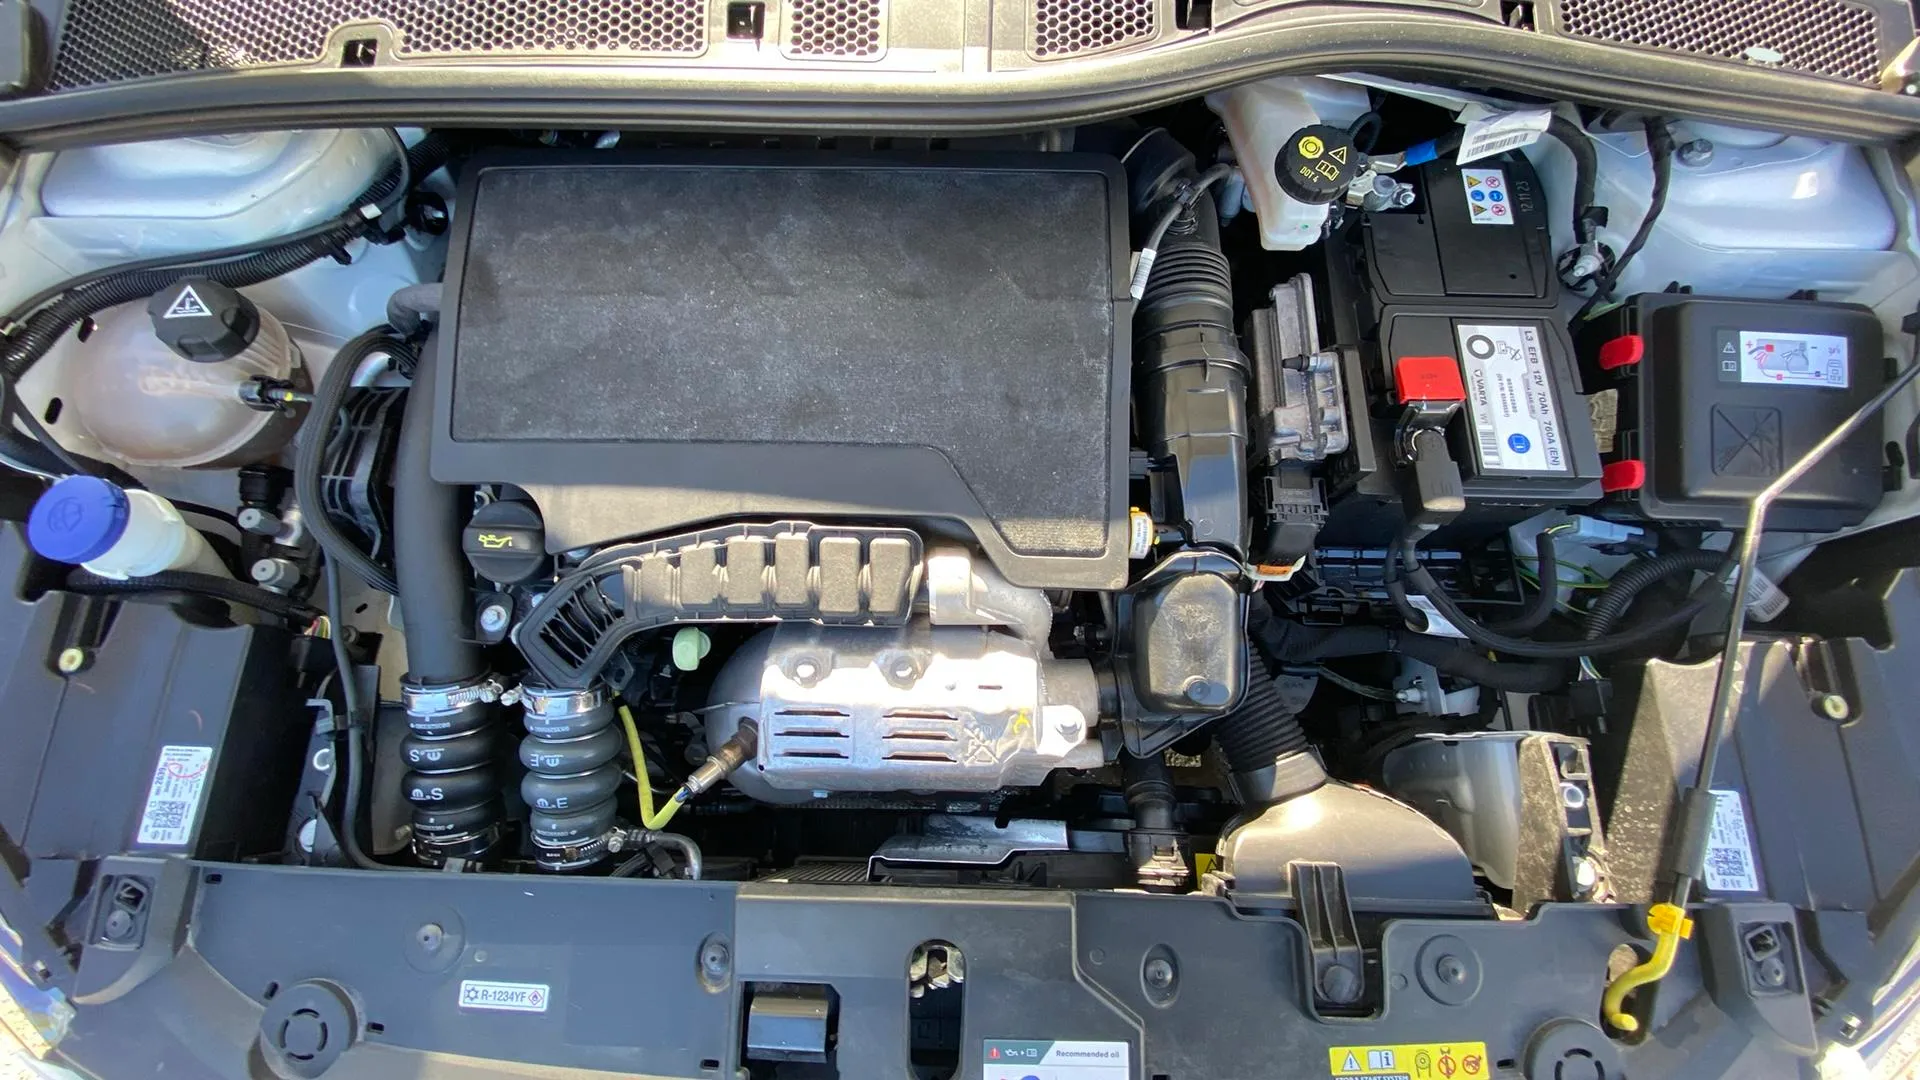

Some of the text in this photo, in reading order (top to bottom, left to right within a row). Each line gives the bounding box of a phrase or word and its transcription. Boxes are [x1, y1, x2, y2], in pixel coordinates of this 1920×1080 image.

[1300, 166, 1319, 183] DOT 4
[1524, 330, 1534, 341] L3
[1528, 346, 1539, 364] EFB
[1532, 370, 1544, 387] 12V
[1475, 378, 1488, 406] VARTA
[1537, 392, 1549, 415] 70Ah
[1543, 421, 1556, 444] 760A
[1547, 447, 1560, 466] (EN)
[481, 989, 527, 1002] R-1234YF
[1055, 1049, 1109, 1058] Recommended
